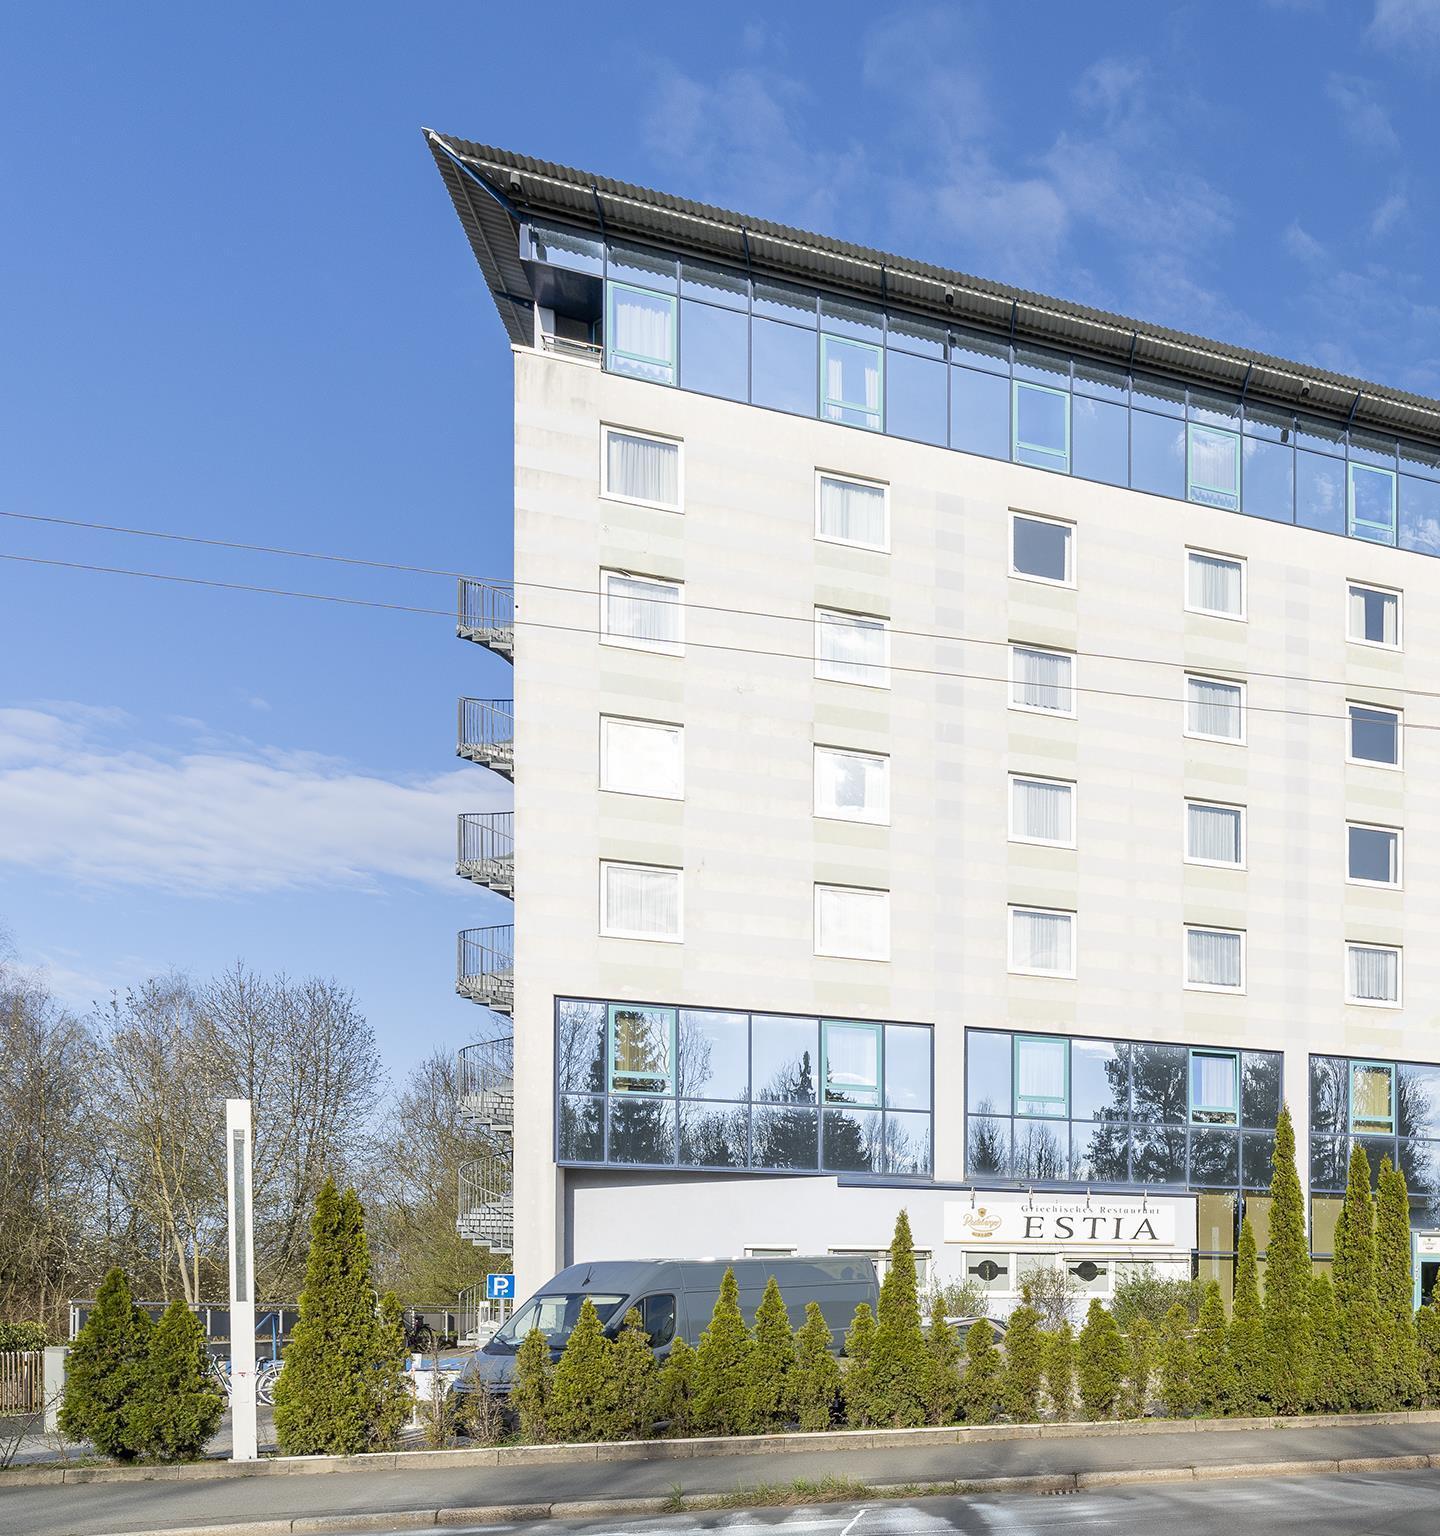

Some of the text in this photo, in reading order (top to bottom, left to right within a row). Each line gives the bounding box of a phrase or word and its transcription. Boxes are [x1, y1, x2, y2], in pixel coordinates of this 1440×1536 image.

[1021, 1204, 1160, 1215] Griechisches Restaurant
[1023, 1215, 1160, 1240] ESTIA
[493, 1277, 509, 1296] P
